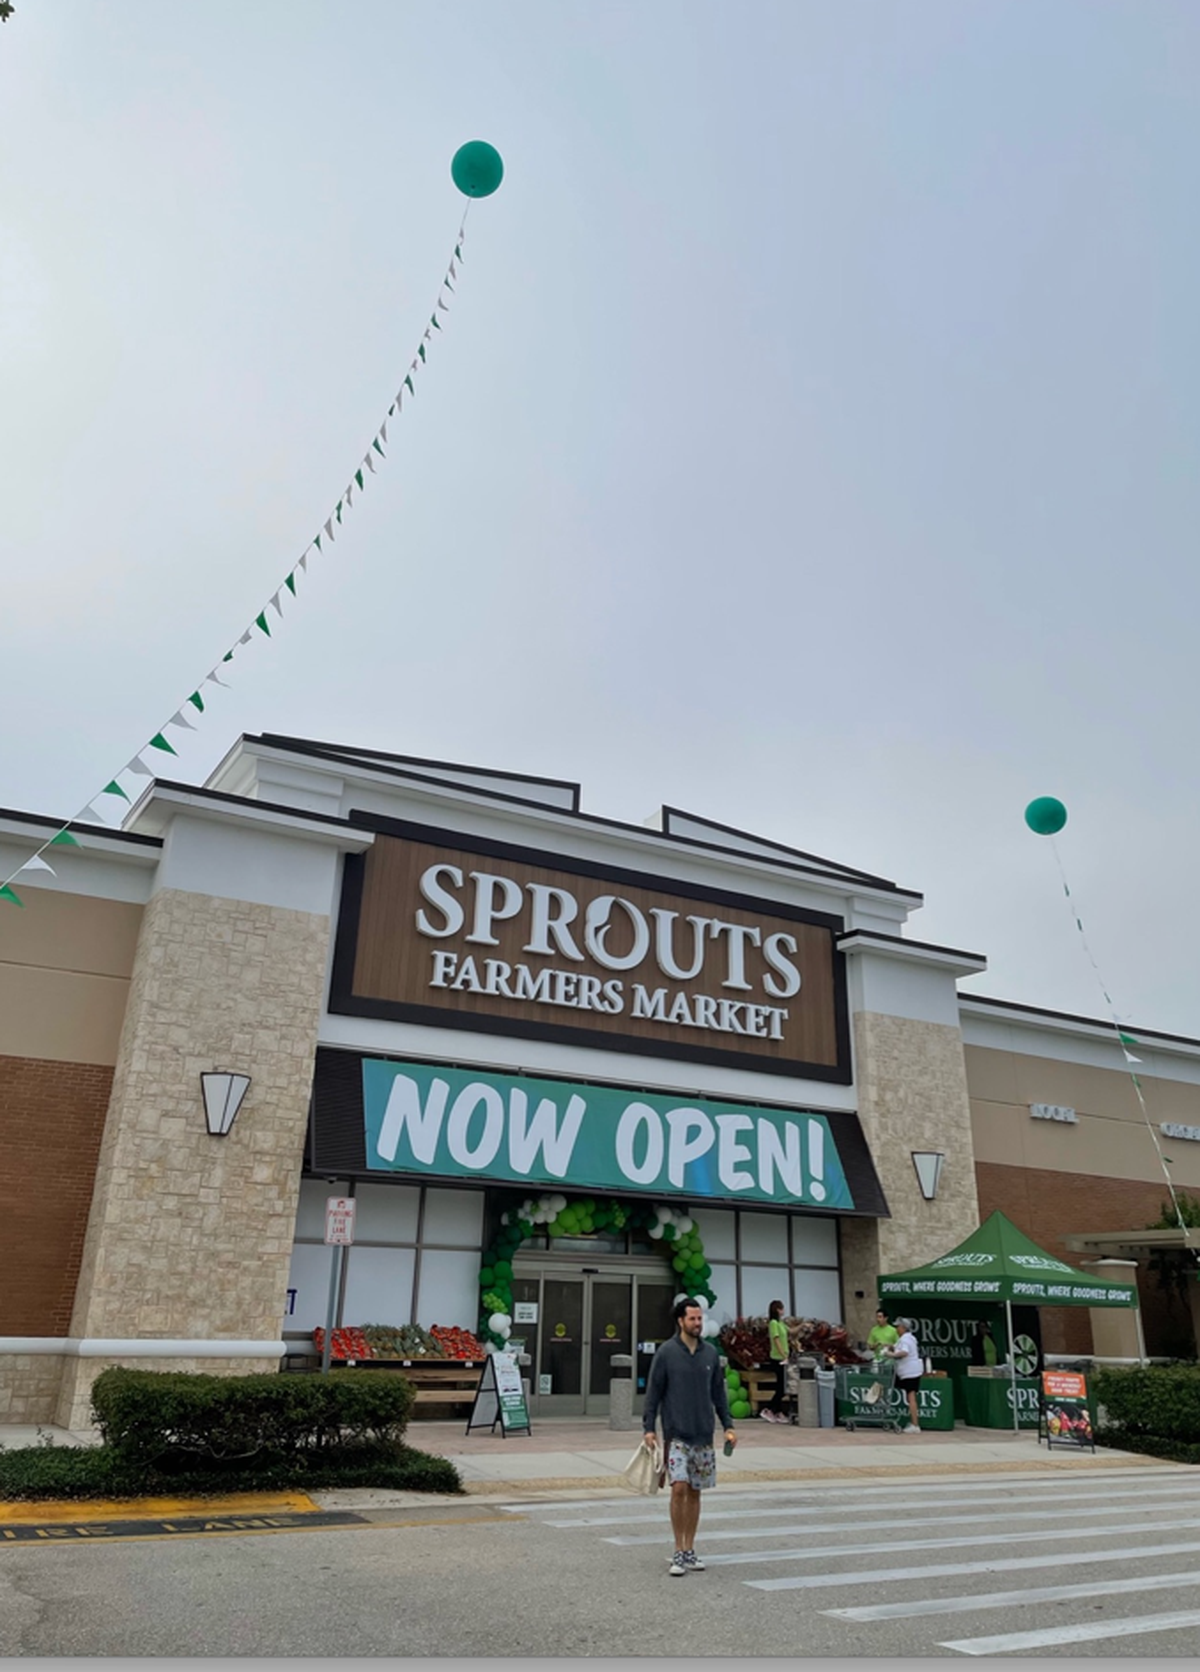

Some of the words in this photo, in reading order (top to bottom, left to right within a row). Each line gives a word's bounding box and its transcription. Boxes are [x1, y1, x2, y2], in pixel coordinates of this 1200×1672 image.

[415, 863, 801, 998] SPROUTS
[430, 950, 624, 1014] FARMERS
[631, 983, 789, 1040] MARKET
[376, 1073, 587, 1178] NOW
[616, 1101, 826, 1201] OPEN!
[329, 1209, 353, 1217] PARKING
[332, 1226, 346, 1234] LANE
[881, 1281, 912, 1294] SPROUTS,
[912, 1281, 936, 1293] WHERE
[936, 1281, 973, 1293] GOODNESS
[973, 1281, 1000, 1293] GROWS
[1012, 1282, 1046, 1297] SPROUTS,
[1047, 1285, 1072, 1298] WHERE
[1072, 1287, 1107, 1300] GOODNESS
[1107, 1289, 1132, 1302] GROWS
[907, 1317, 993, 1344] PROUT
[949, 1345, 973, 1359] MAR
[2, 1526, 114, 1539] IRE
[161, 1517, 298, 1533] LANE
